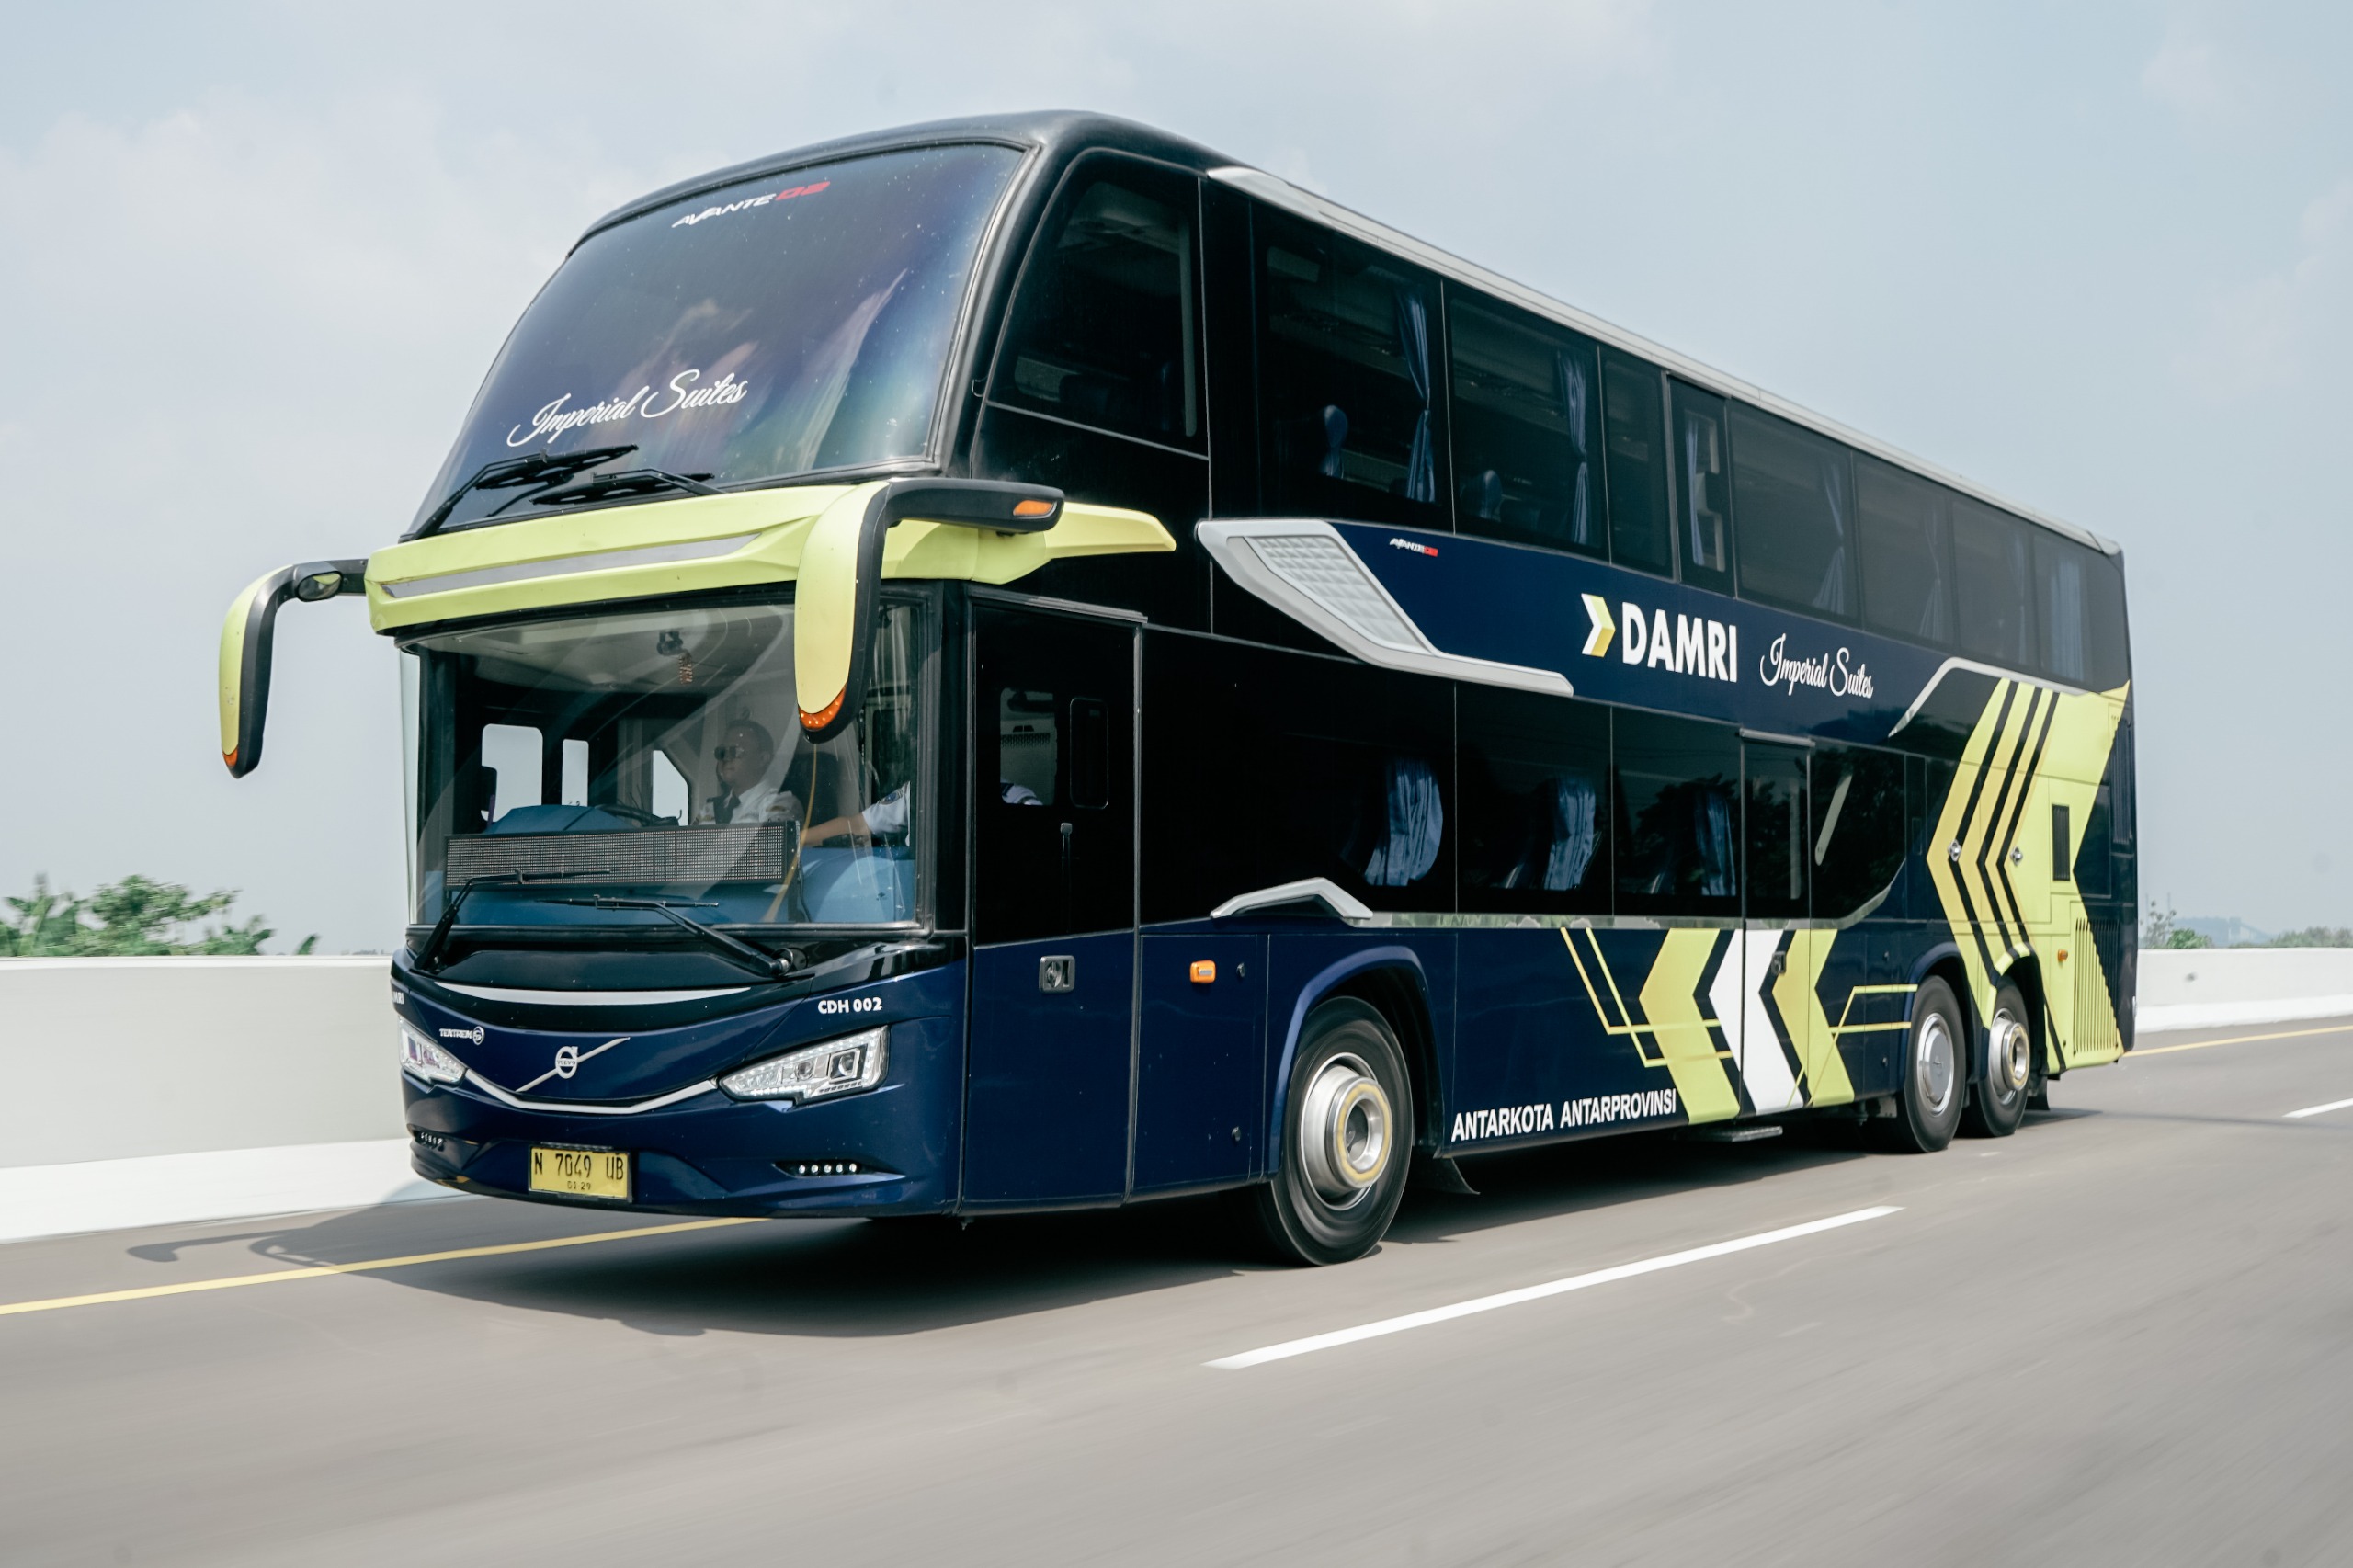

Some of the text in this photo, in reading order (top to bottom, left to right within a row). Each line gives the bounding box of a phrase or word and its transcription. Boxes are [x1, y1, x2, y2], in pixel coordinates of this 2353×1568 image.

[671, 193, 777, 228] AVANTE
[506, 369, 748, 448] Imperial Suites
[1621, 601, 1737, 683] DAMRI
[1759, 632, 1874, 699] Imperial Suites
[817, 996, 883, 1015] CDH 002
[1450, 1087, 1677, 1142] ANTARKOTA ANTARPROVINSI
[534, 1152, 624, 1180] N 7049 UB
